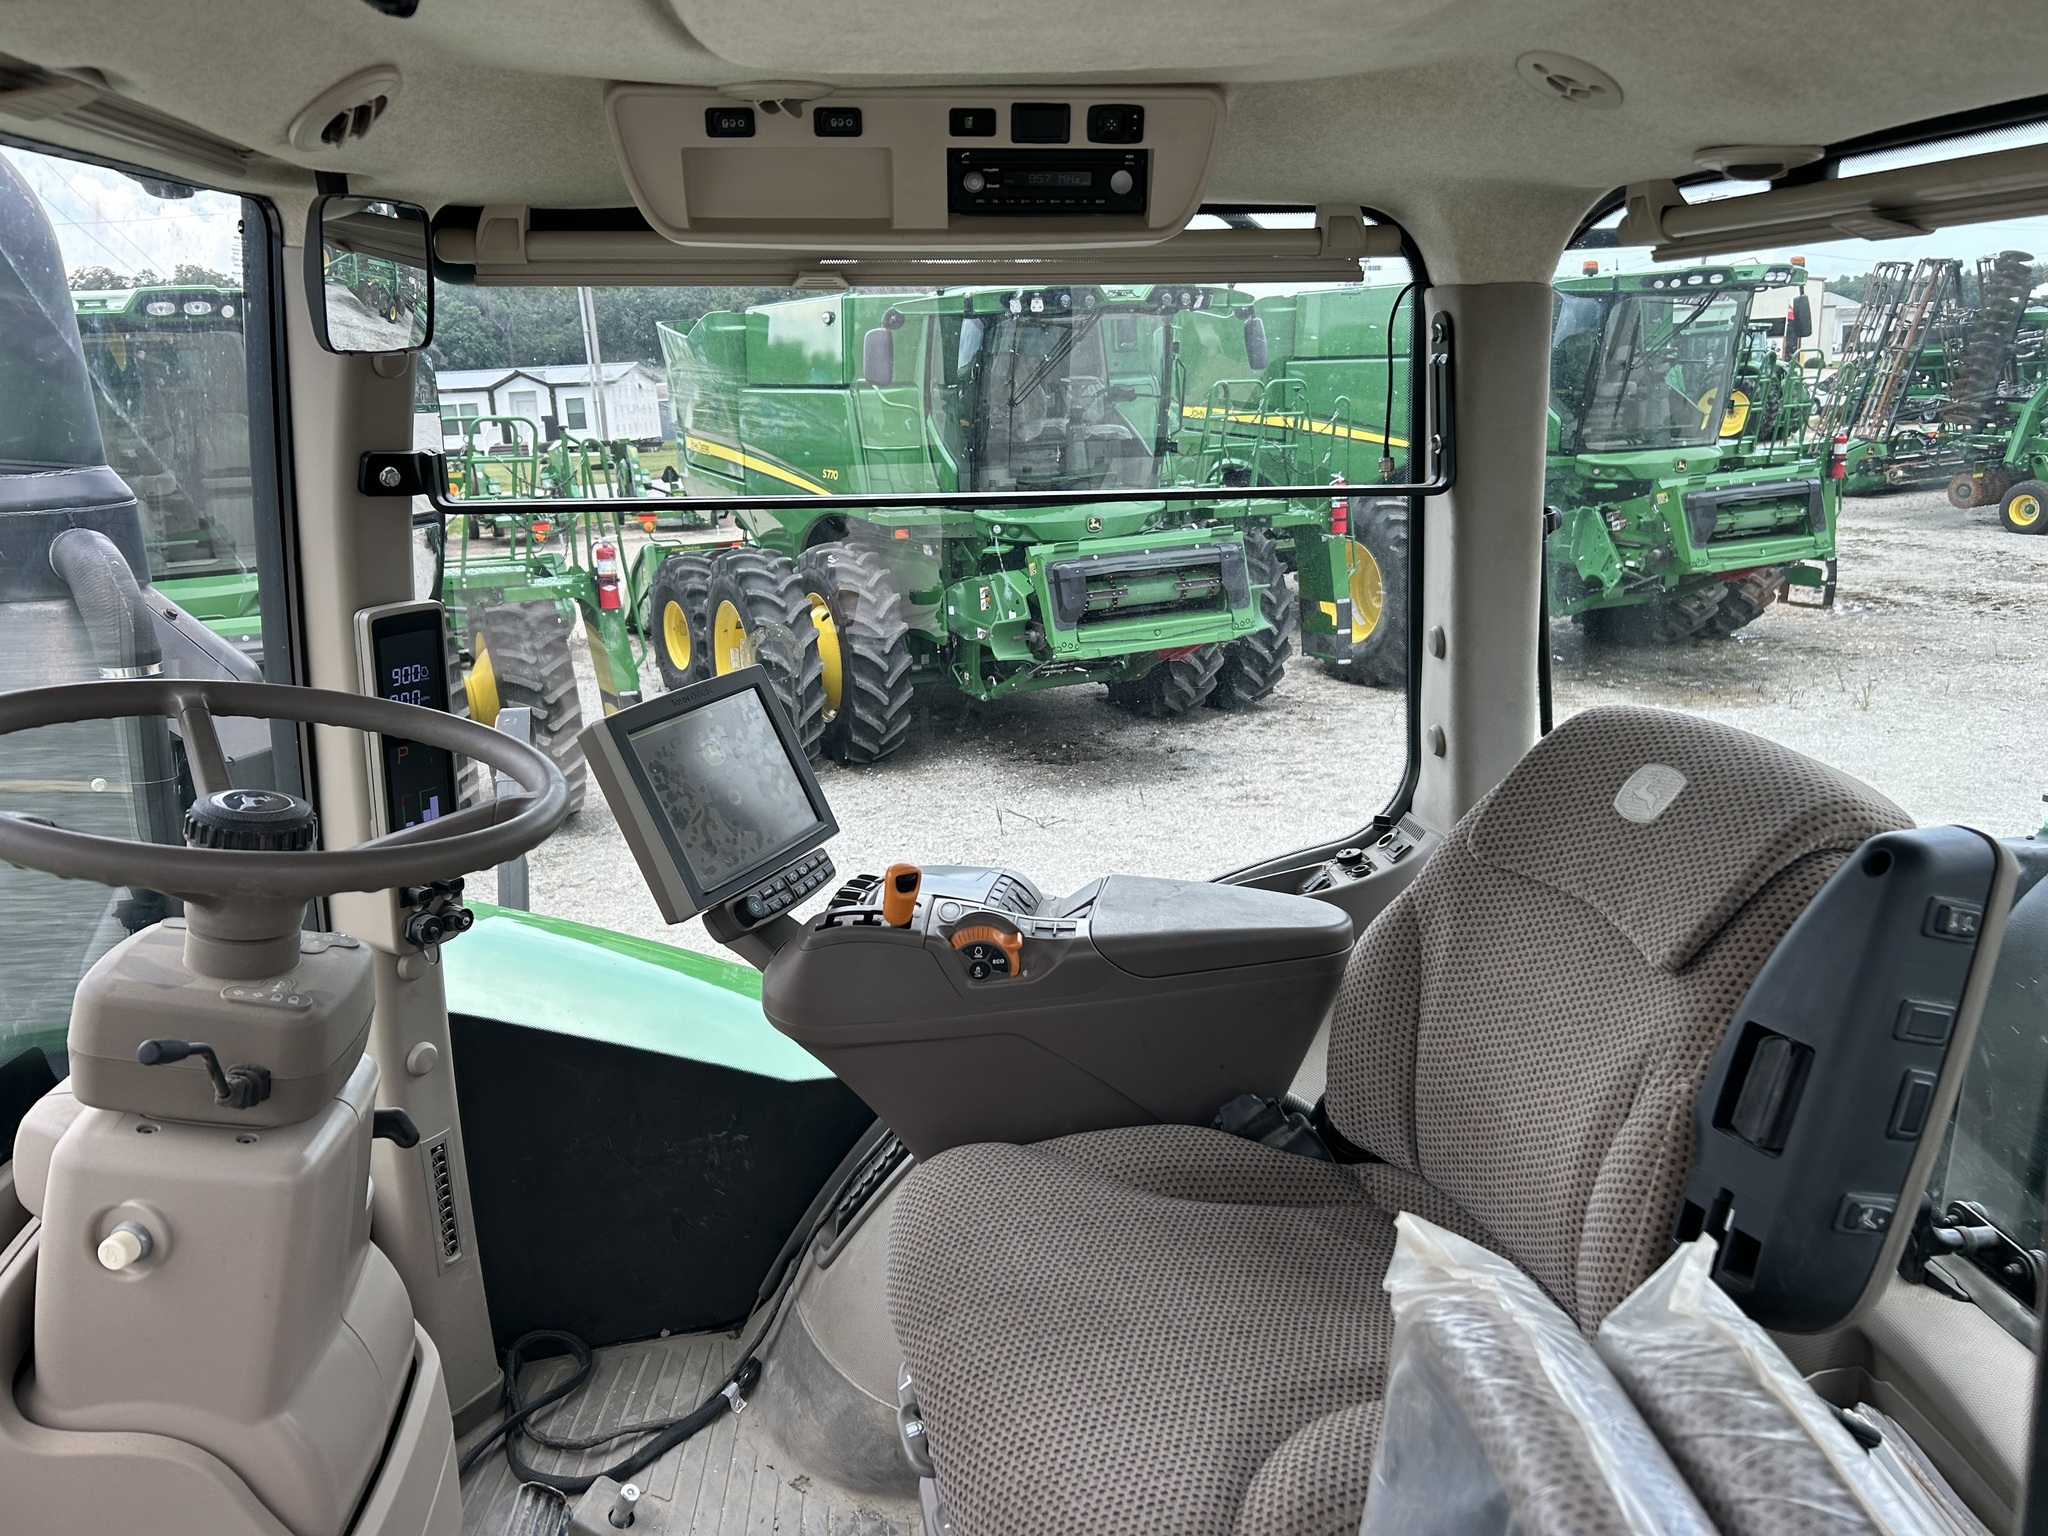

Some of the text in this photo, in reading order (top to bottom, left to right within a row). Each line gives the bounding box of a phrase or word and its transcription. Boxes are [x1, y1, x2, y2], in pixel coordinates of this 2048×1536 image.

[1058, 173, 1081, 184] MHz
[822, 468, 839, 480] S770
[392, 664, 420, 687] 900
[671, 695, 690, 707] JOHN
[397, 746, 409, 766] P
